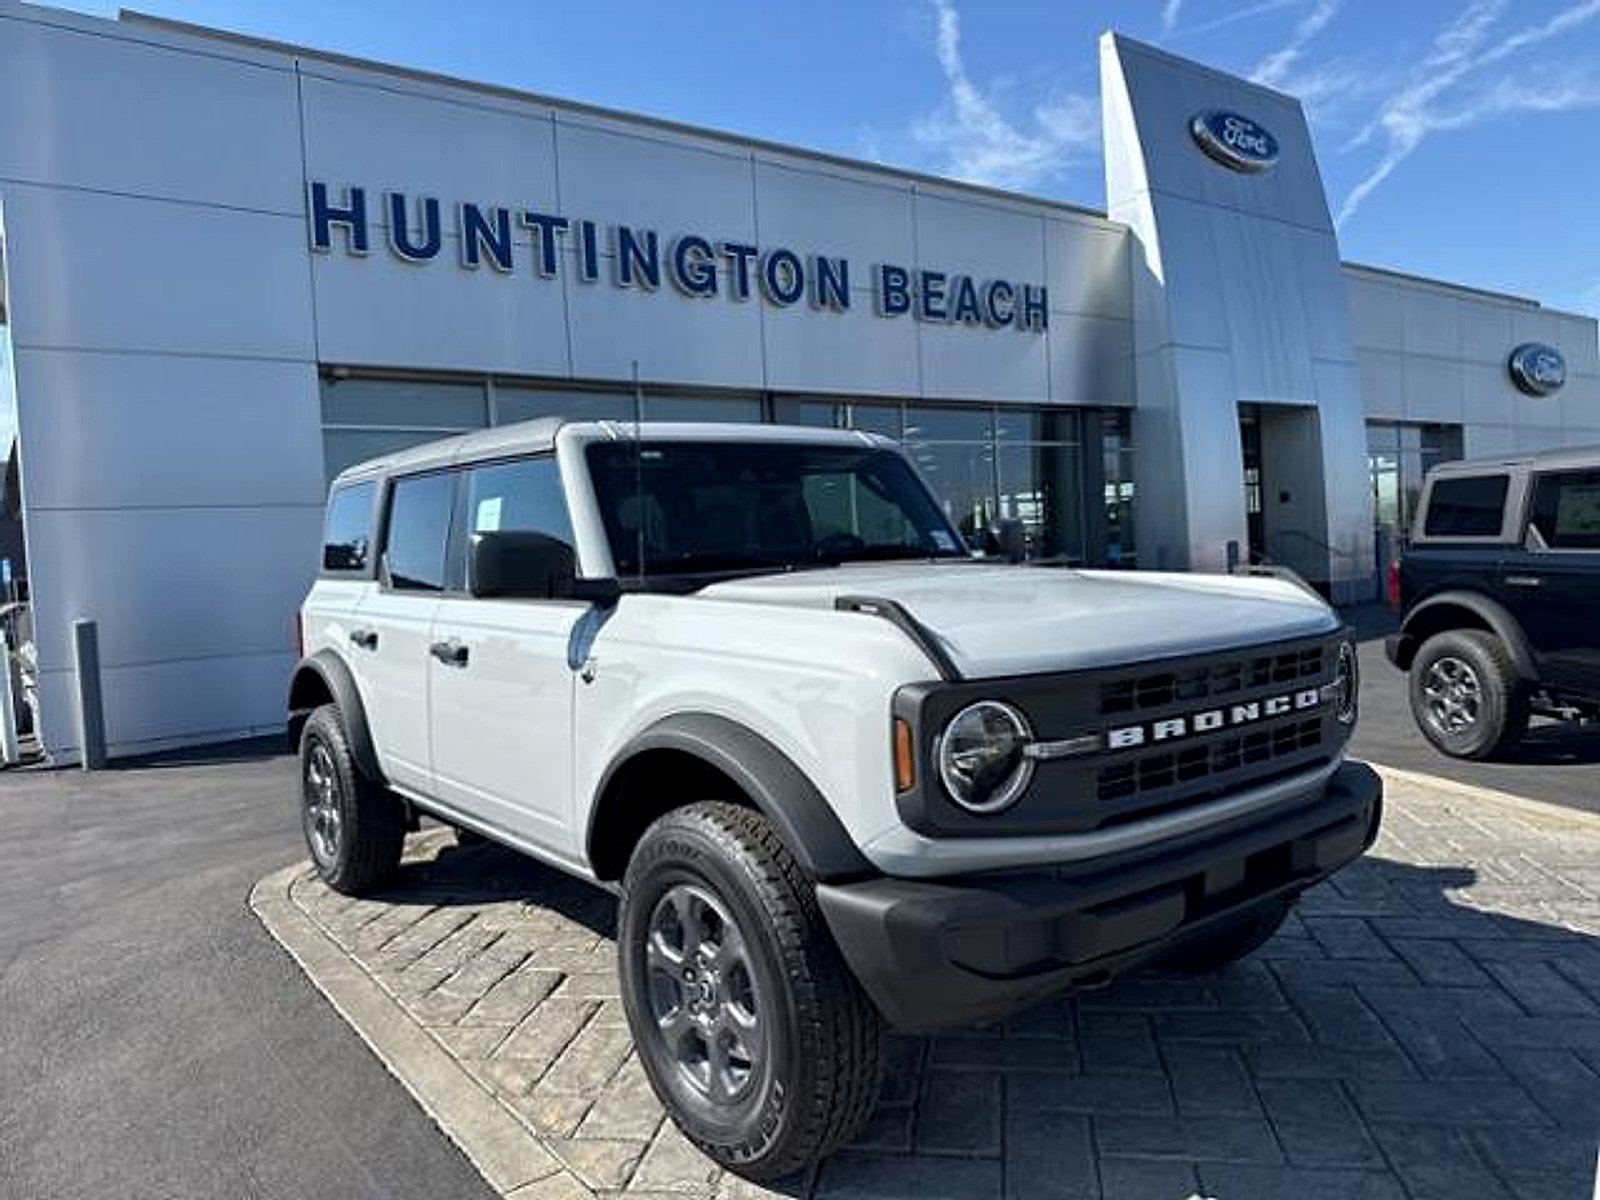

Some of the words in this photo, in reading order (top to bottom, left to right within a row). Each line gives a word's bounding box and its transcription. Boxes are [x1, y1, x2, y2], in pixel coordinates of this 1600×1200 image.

[1223, 117, 1267, 155] Ford
[310, 181, 850, 312] HUNTINGTON
[880, 264, 1050, 332] BEACH
[1108, 688, 1320, 750] BRONCO
